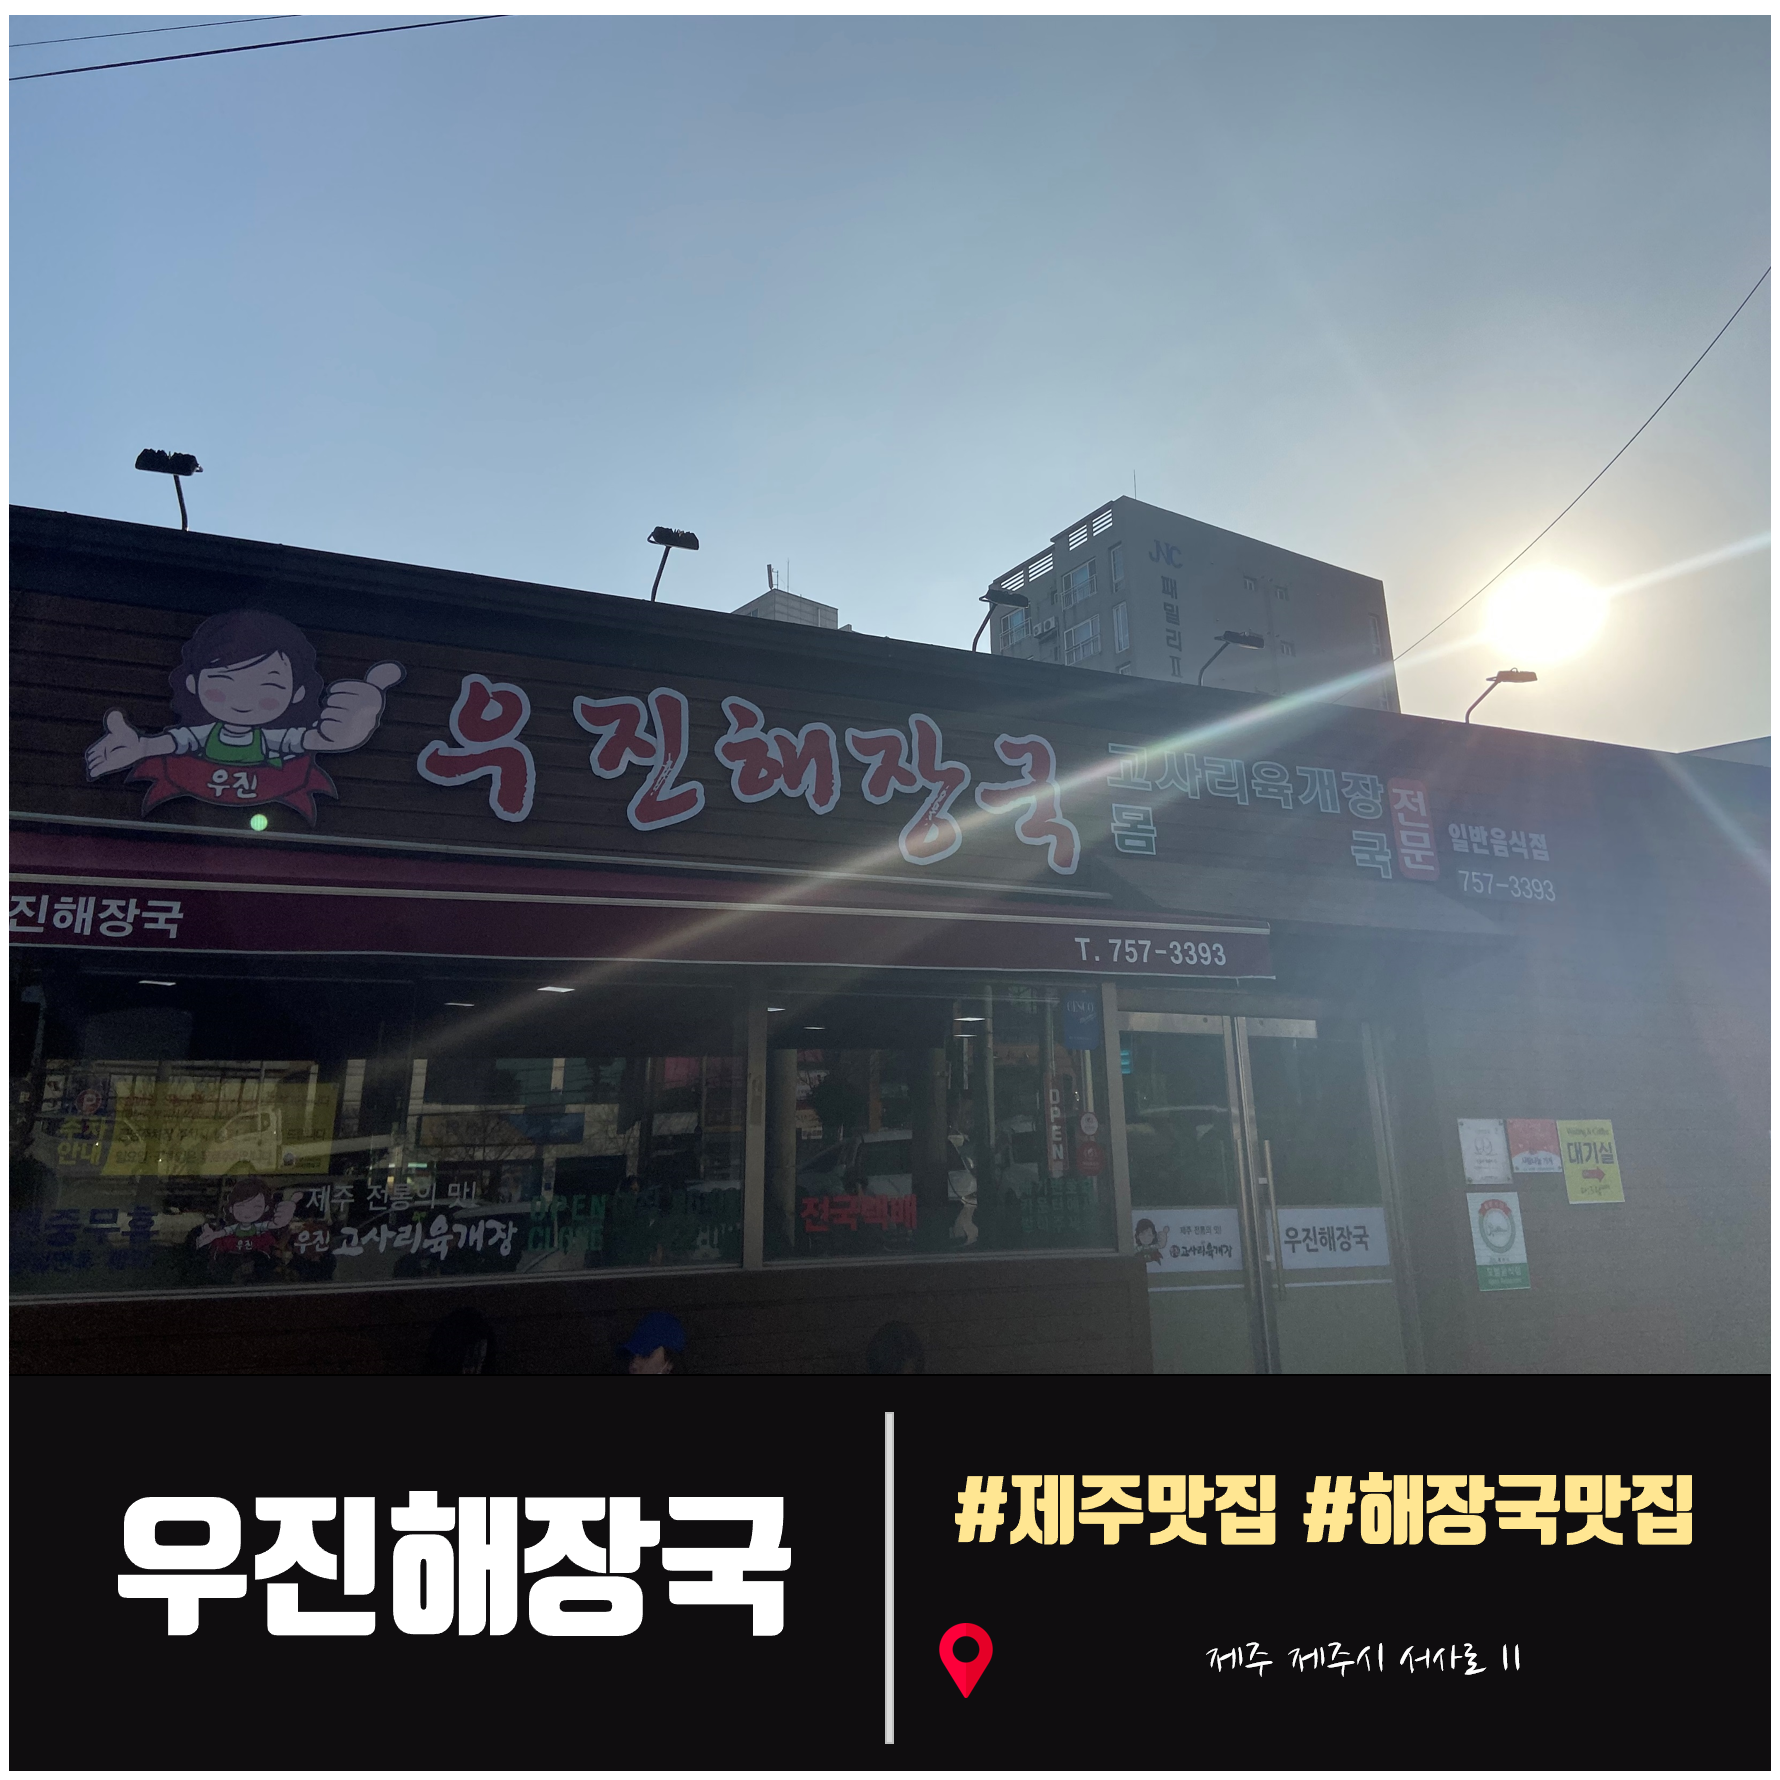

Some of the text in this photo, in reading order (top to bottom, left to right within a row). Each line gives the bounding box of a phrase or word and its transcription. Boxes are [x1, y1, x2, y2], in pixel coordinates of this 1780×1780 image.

[1148, 539, 1184, 570] JNC
[206, 766, 259, 799] 우진
[417, 672, 1082, 876] 우진해장국
[1108, 743, 1385, 820] 고사리육개장
[1448, 822, 1551, 862] 일반음식점
[1458, 869, 1557, 903] 757-3393
[1074, 937, 1228, 967] T. 757-3393
[1048, 1088, 1065, 1161] OPEN
[57, 1140, 105, 1166] 안내
[1566, 1141, 1615, 1165] 대기실
[306, 1184, 355, 1212] 제주
[366, 1182, 437, 1212] 전통의
[530, 1193, 609, 1221] OPEN
[293, 1218, 518, 1261] 우진 고사리육개장
[1181, 1242, 1233, 1259] 고사리육개장
[1283, 1224, 1371, 1254] 우진해장국
